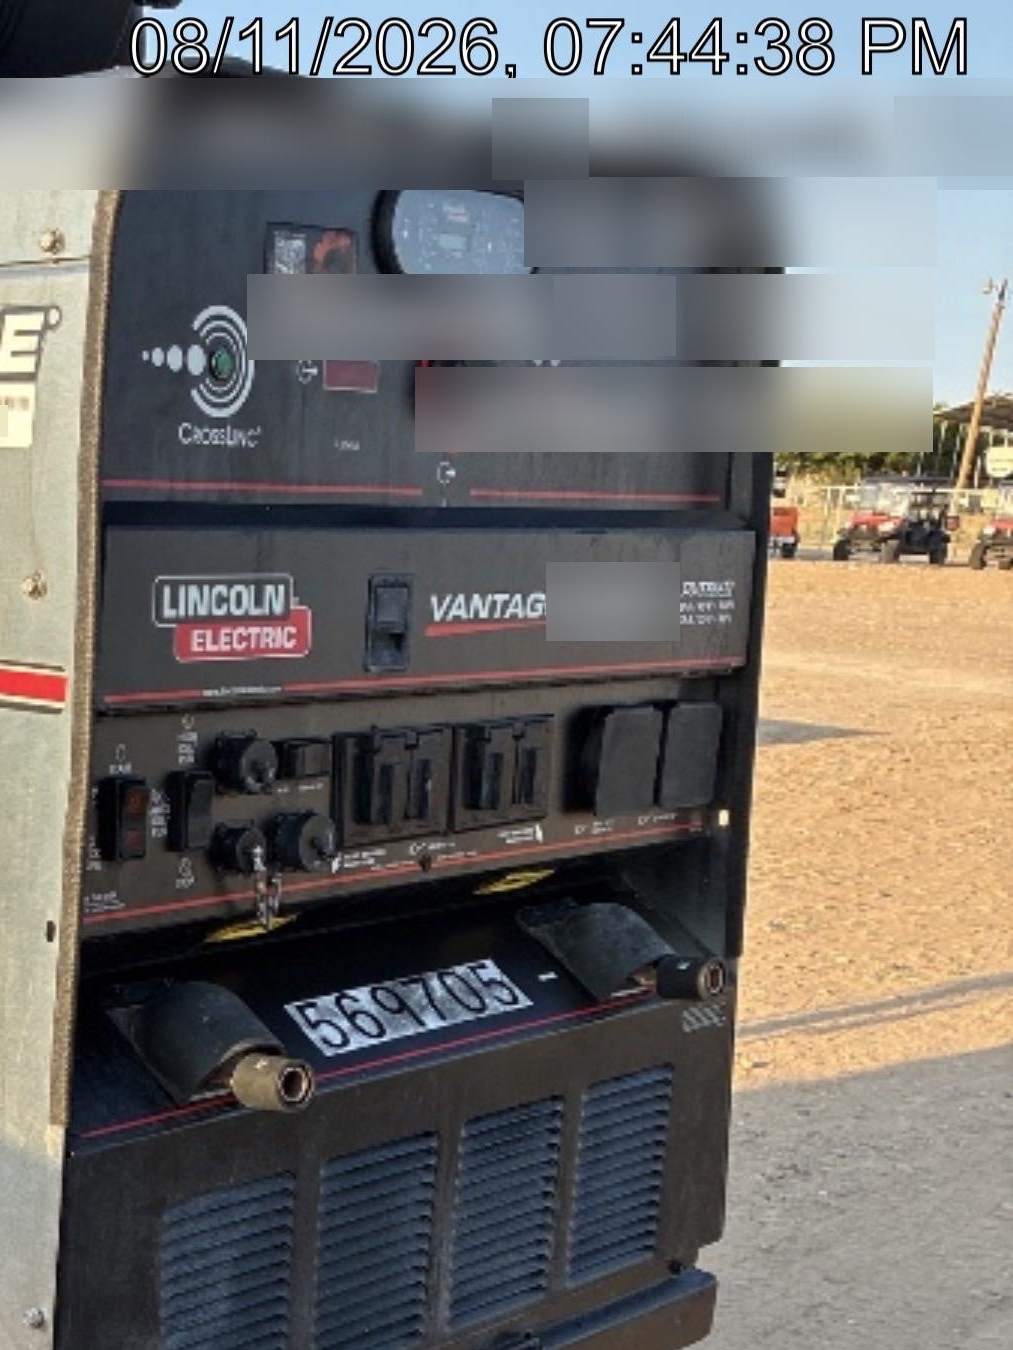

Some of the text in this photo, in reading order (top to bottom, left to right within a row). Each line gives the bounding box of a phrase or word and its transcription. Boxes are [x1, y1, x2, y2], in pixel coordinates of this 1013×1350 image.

[162, 584, 286, 620] LINCOLN
[430, 591, 546, 622] VANTAG
[190, 626, 297, 653] ELECTRIC
[296, 961, 521, 1049] 569705
